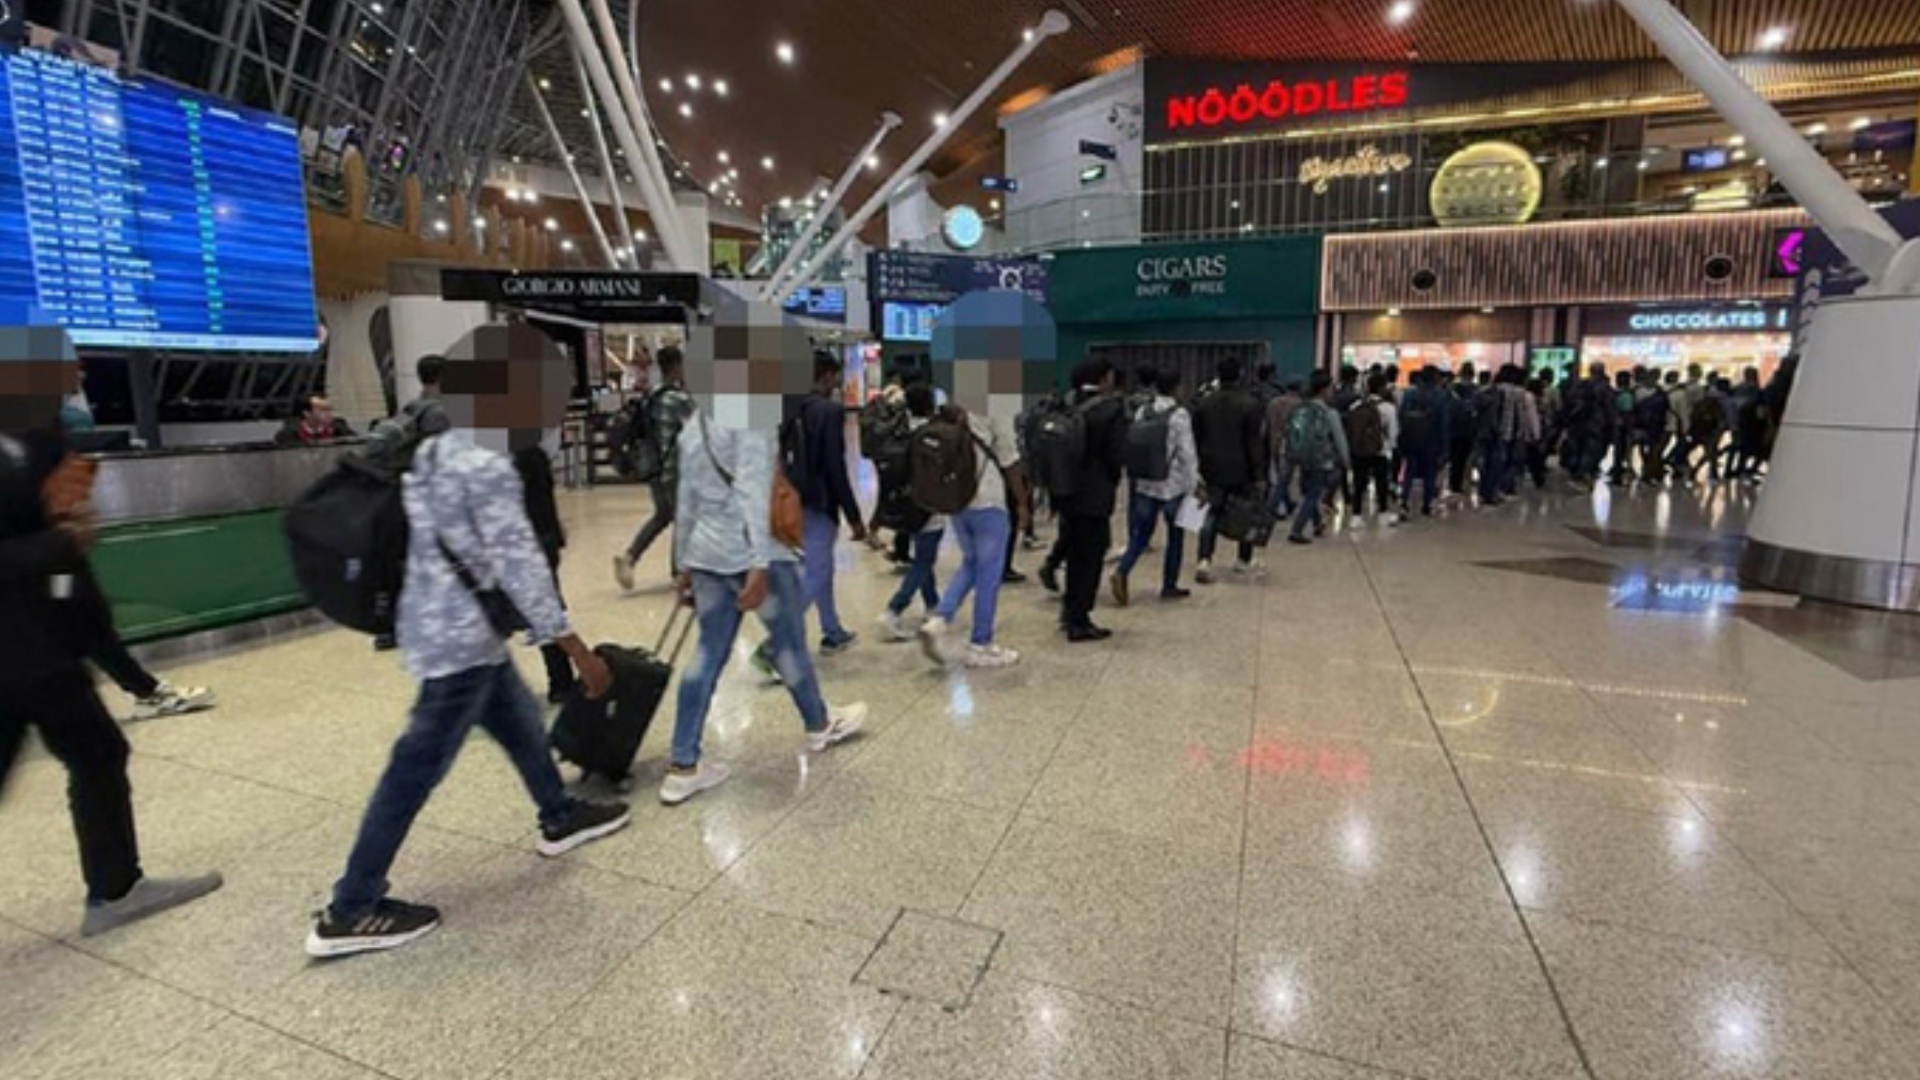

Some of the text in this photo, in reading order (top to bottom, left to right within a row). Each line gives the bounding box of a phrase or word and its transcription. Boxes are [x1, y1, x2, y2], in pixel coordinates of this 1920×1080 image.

[1137, 254, 1227, 281] CIGARS
[502, 277, 641, 297] GIORGIO ARMANI
[1191, 281, 1225, 295] FREE
[1629, 310, 1767, 331] CHOCOLATES
